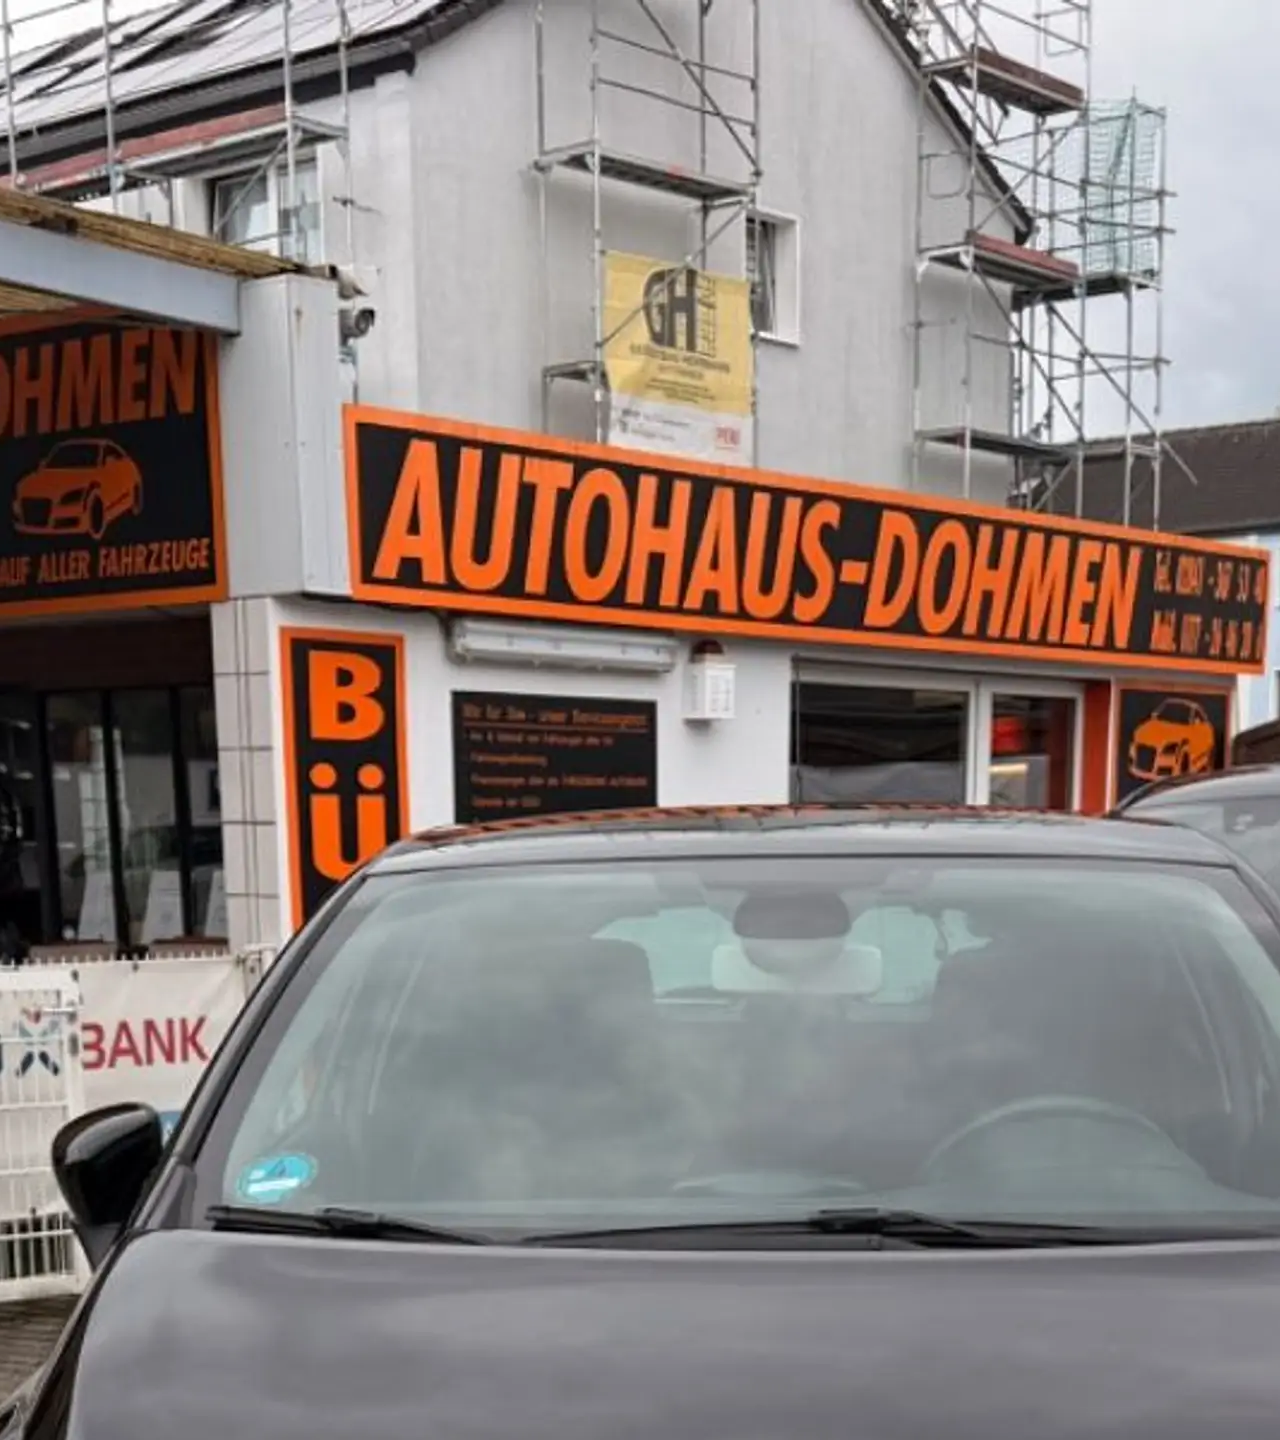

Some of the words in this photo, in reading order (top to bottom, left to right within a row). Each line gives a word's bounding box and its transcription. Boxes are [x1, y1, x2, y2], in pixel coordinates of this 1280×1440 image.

[38, 551, 91, 584] ALLER
[99, 537, 210, 577] FAHRZEUGE
[372, 438, 1143, 650] AUTOHAUS-DOHMEN
[81, 1016, 211, 1072] BANK
